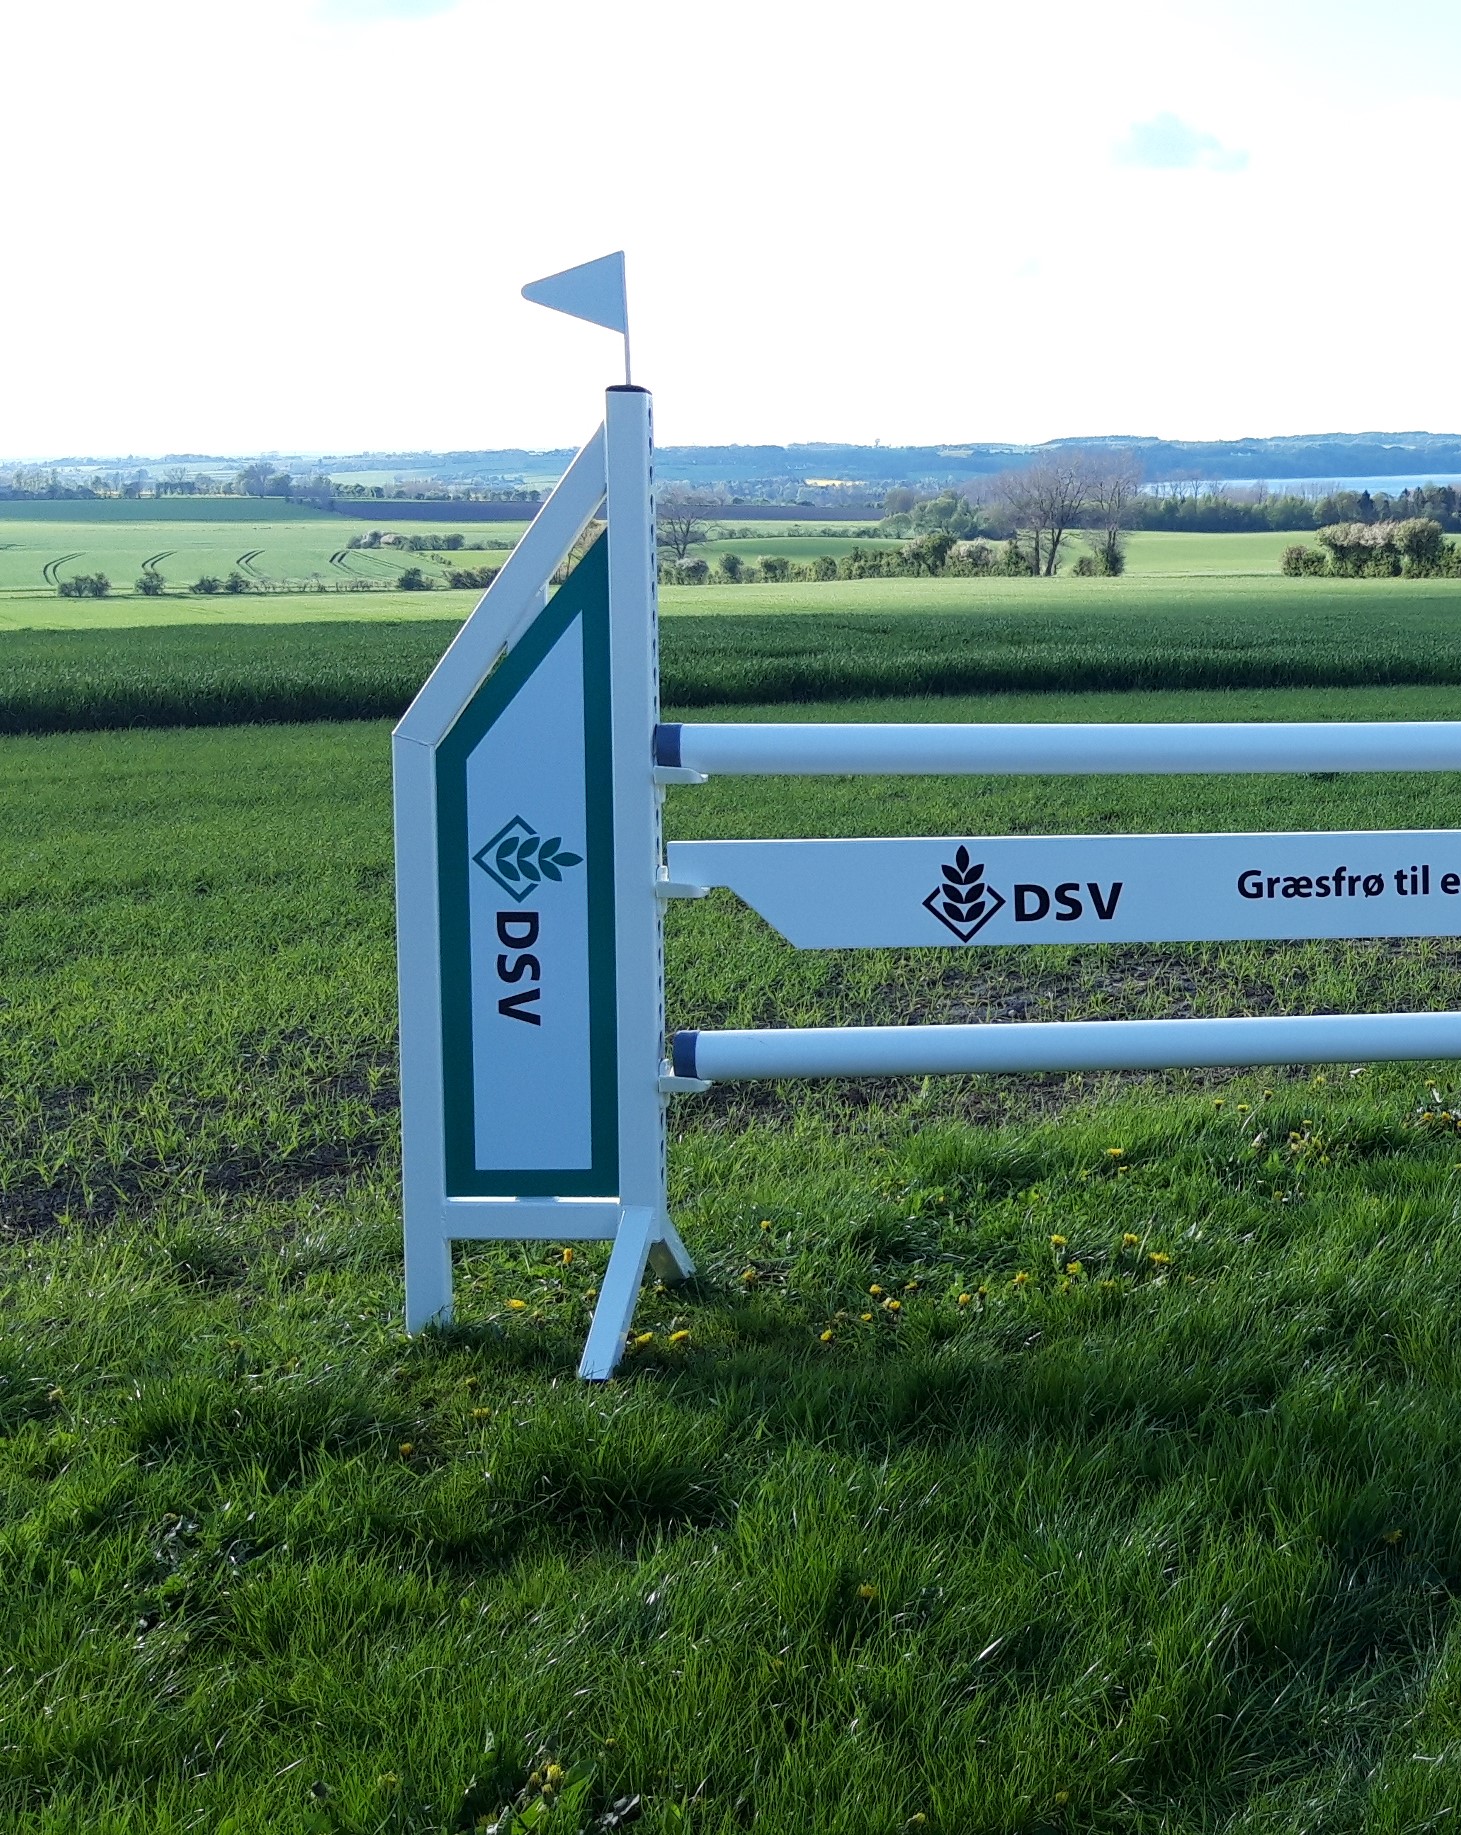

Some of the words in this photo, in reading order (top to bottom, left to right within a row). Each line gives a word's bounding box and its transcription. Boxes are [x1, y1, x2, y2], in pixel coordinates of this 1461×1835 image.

[1237, 865, 1385, 899] Græsfrø
[1393, 864, 1430, 896] til
[1013, 882, 1124, 922] DSV
[495, 911, 542, 1027] DSV
